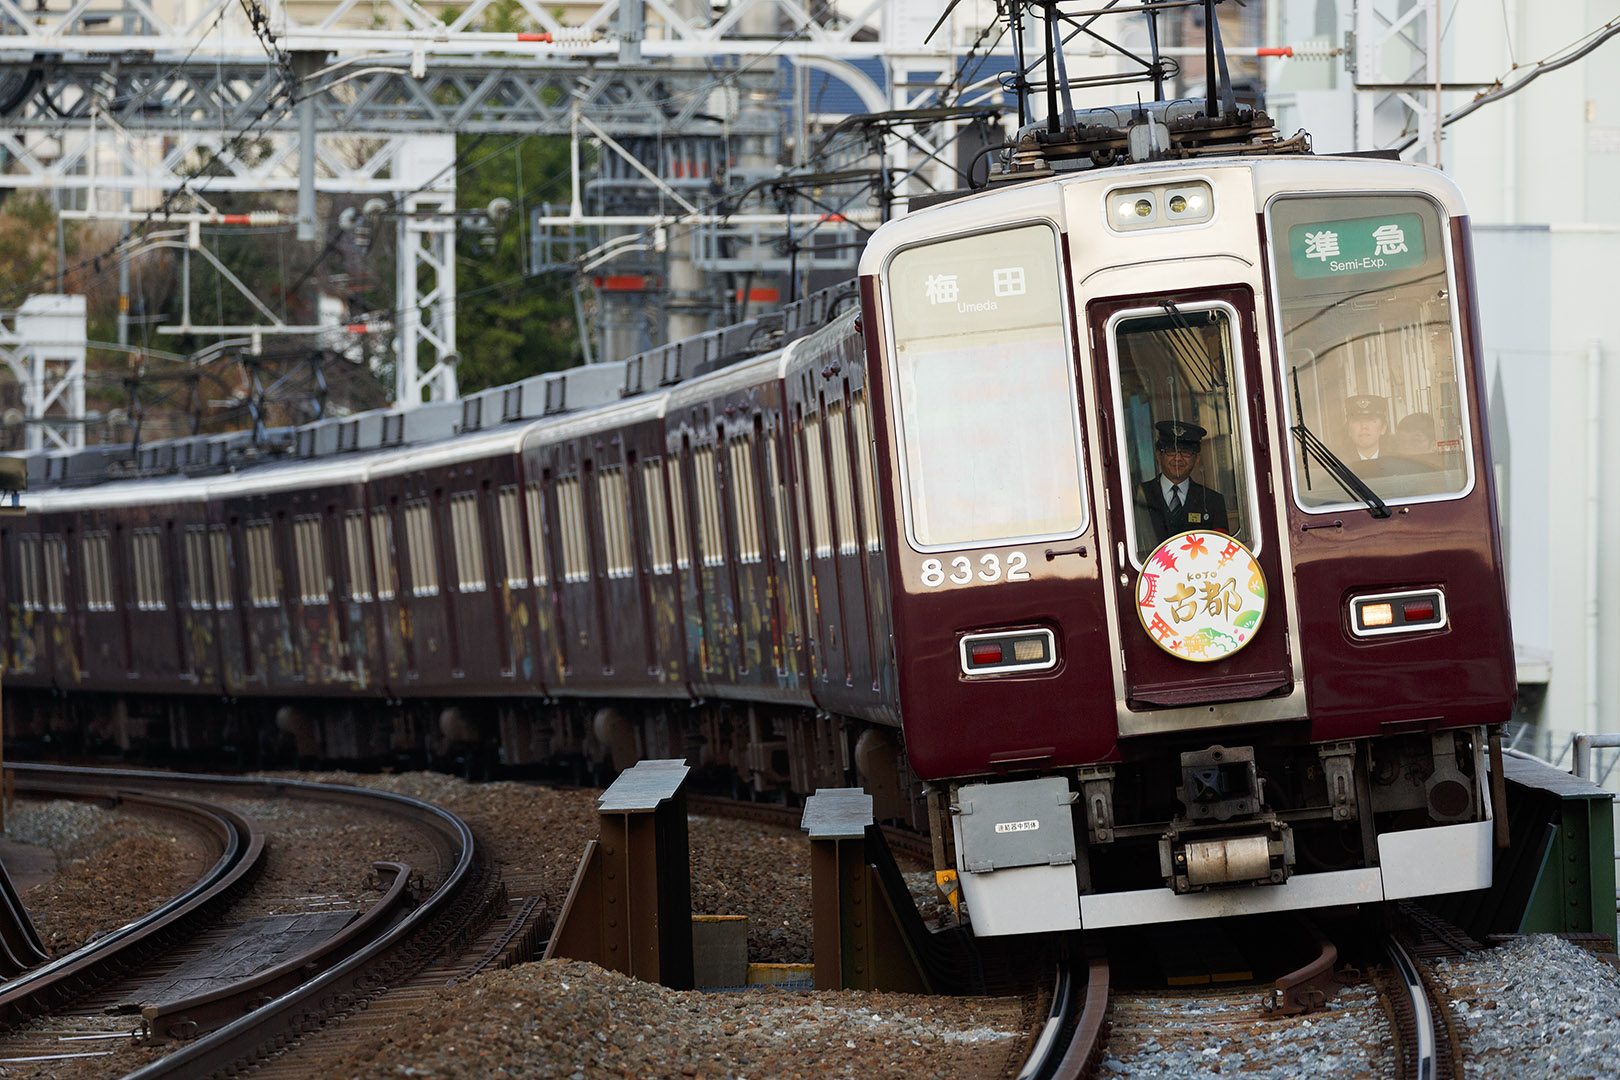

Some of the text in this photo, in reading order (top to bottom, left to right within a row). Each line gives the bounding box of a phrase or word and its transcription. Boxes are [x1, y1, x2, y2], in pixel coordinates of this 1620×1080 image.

[1304, 224, 1408, 262] 準急
[1329, 257, 1387, 272] Semi-Exp.
[925, 266, 1026, 304] 梅田
[957, 299, 998, 313] Umeda
[921, 551, 1030, 587] 8332
[1163, 577, 1242, 624] 古都
